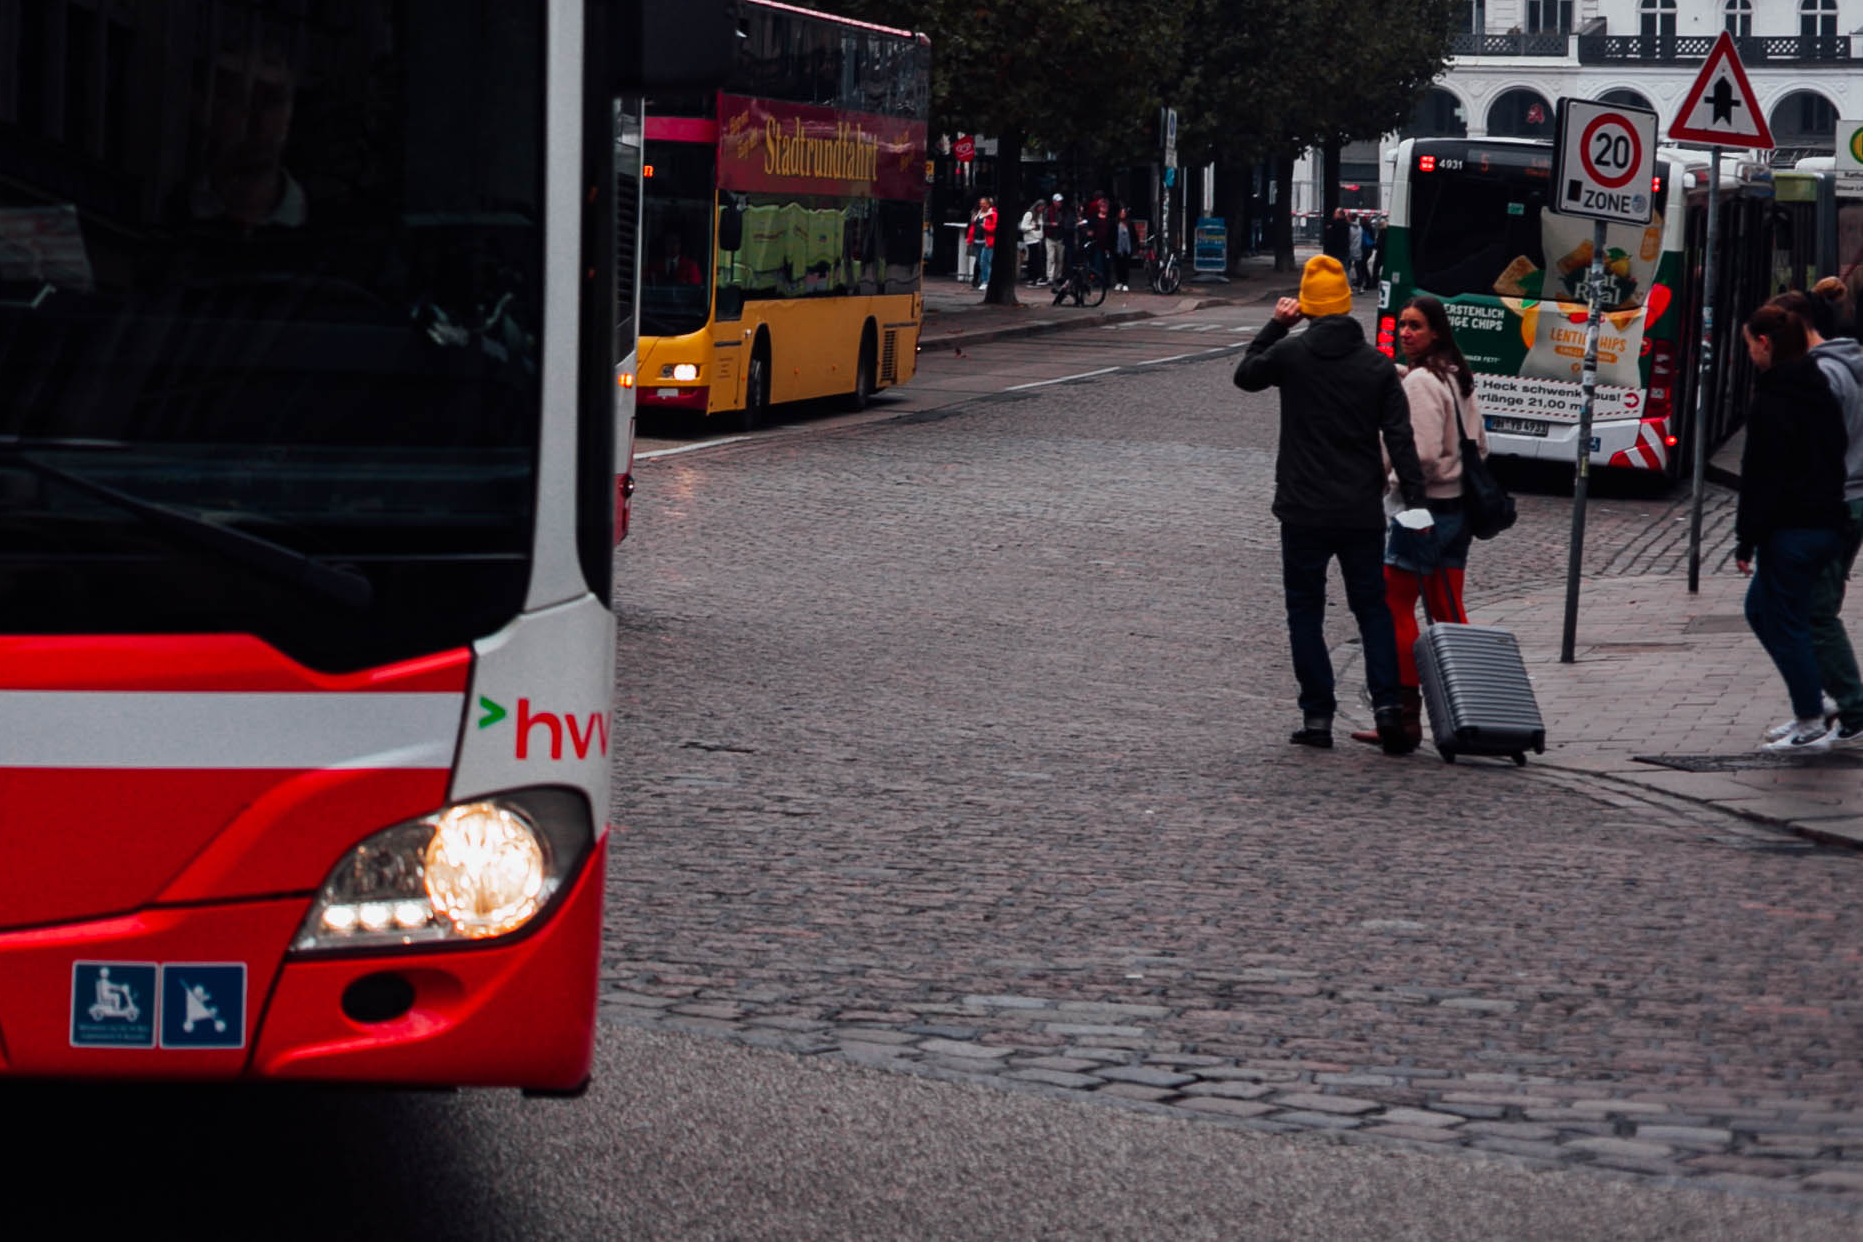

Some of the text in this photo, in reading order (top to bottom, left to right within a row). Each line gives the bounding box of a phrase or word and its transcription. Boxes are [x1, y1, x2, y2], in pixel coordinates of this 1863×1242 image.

[764, 115, 879, 181] Stadtrundfahrt
[1594, 132, 1631, 169] 20
[1439, 159, 1463, 170] 4931
[1583, 189, 1631, 214] ZONE
[1575, 283, 1622, 305] Ral
[1471, 318, 1503, 332] CHIPS
[1599, 335, 1626, 352] HIPS
[1483, 380, 1518, 392] Heck
[1522, 384, 1583, 399] schwenk
[1528, 397, 1566, 409] 21,00
